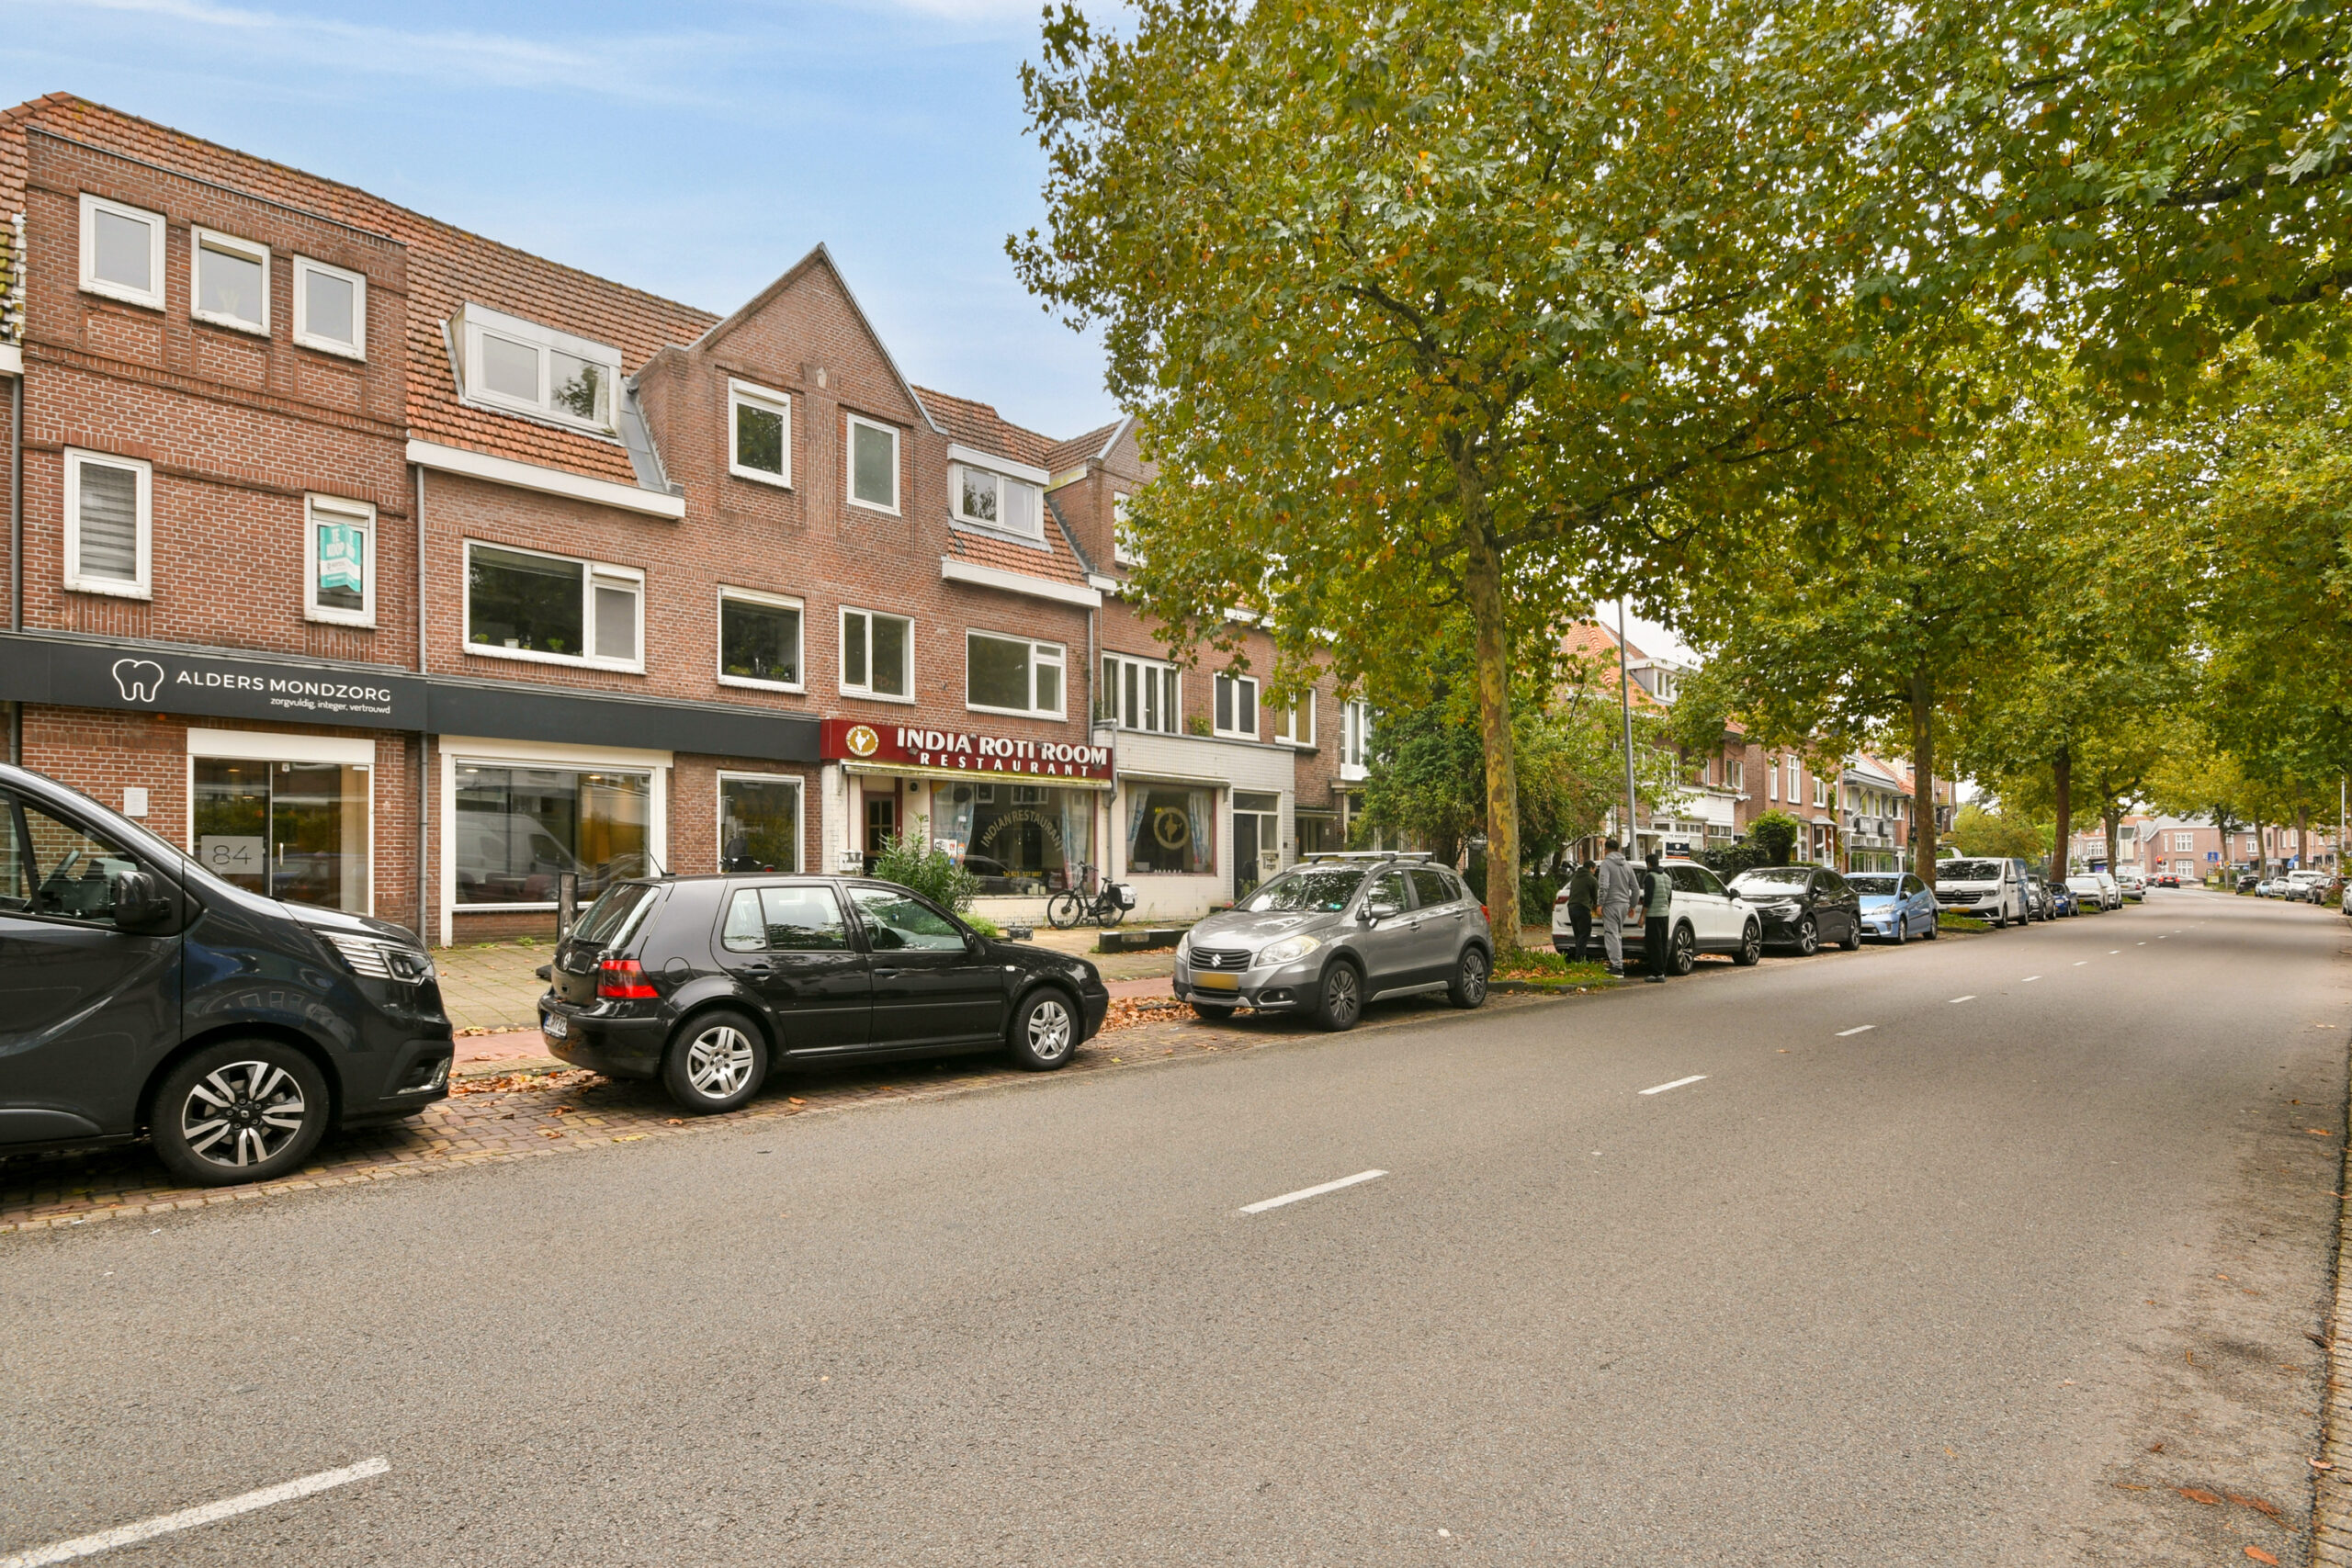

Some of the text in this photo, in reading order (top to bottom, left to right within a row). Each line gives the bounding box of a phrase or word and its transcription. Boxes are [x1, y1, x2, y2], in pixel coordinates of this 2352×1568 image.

[176, 671, 390, 702] ALDERS MONDZORG
[270, 697, 390, 714] zorgvuldig, integer, vertrouwd
[897, 728, 973, 754] INDIA
[979, 736, 1035, 759] ROTI
[1041, 742, 1107, 765] ROOM
[920, 752, 1089, 777] RESTAURANT
[980, 809, 1063, 852] INDIAN RESTAURANT
[212, 844, 253, 865] 84
